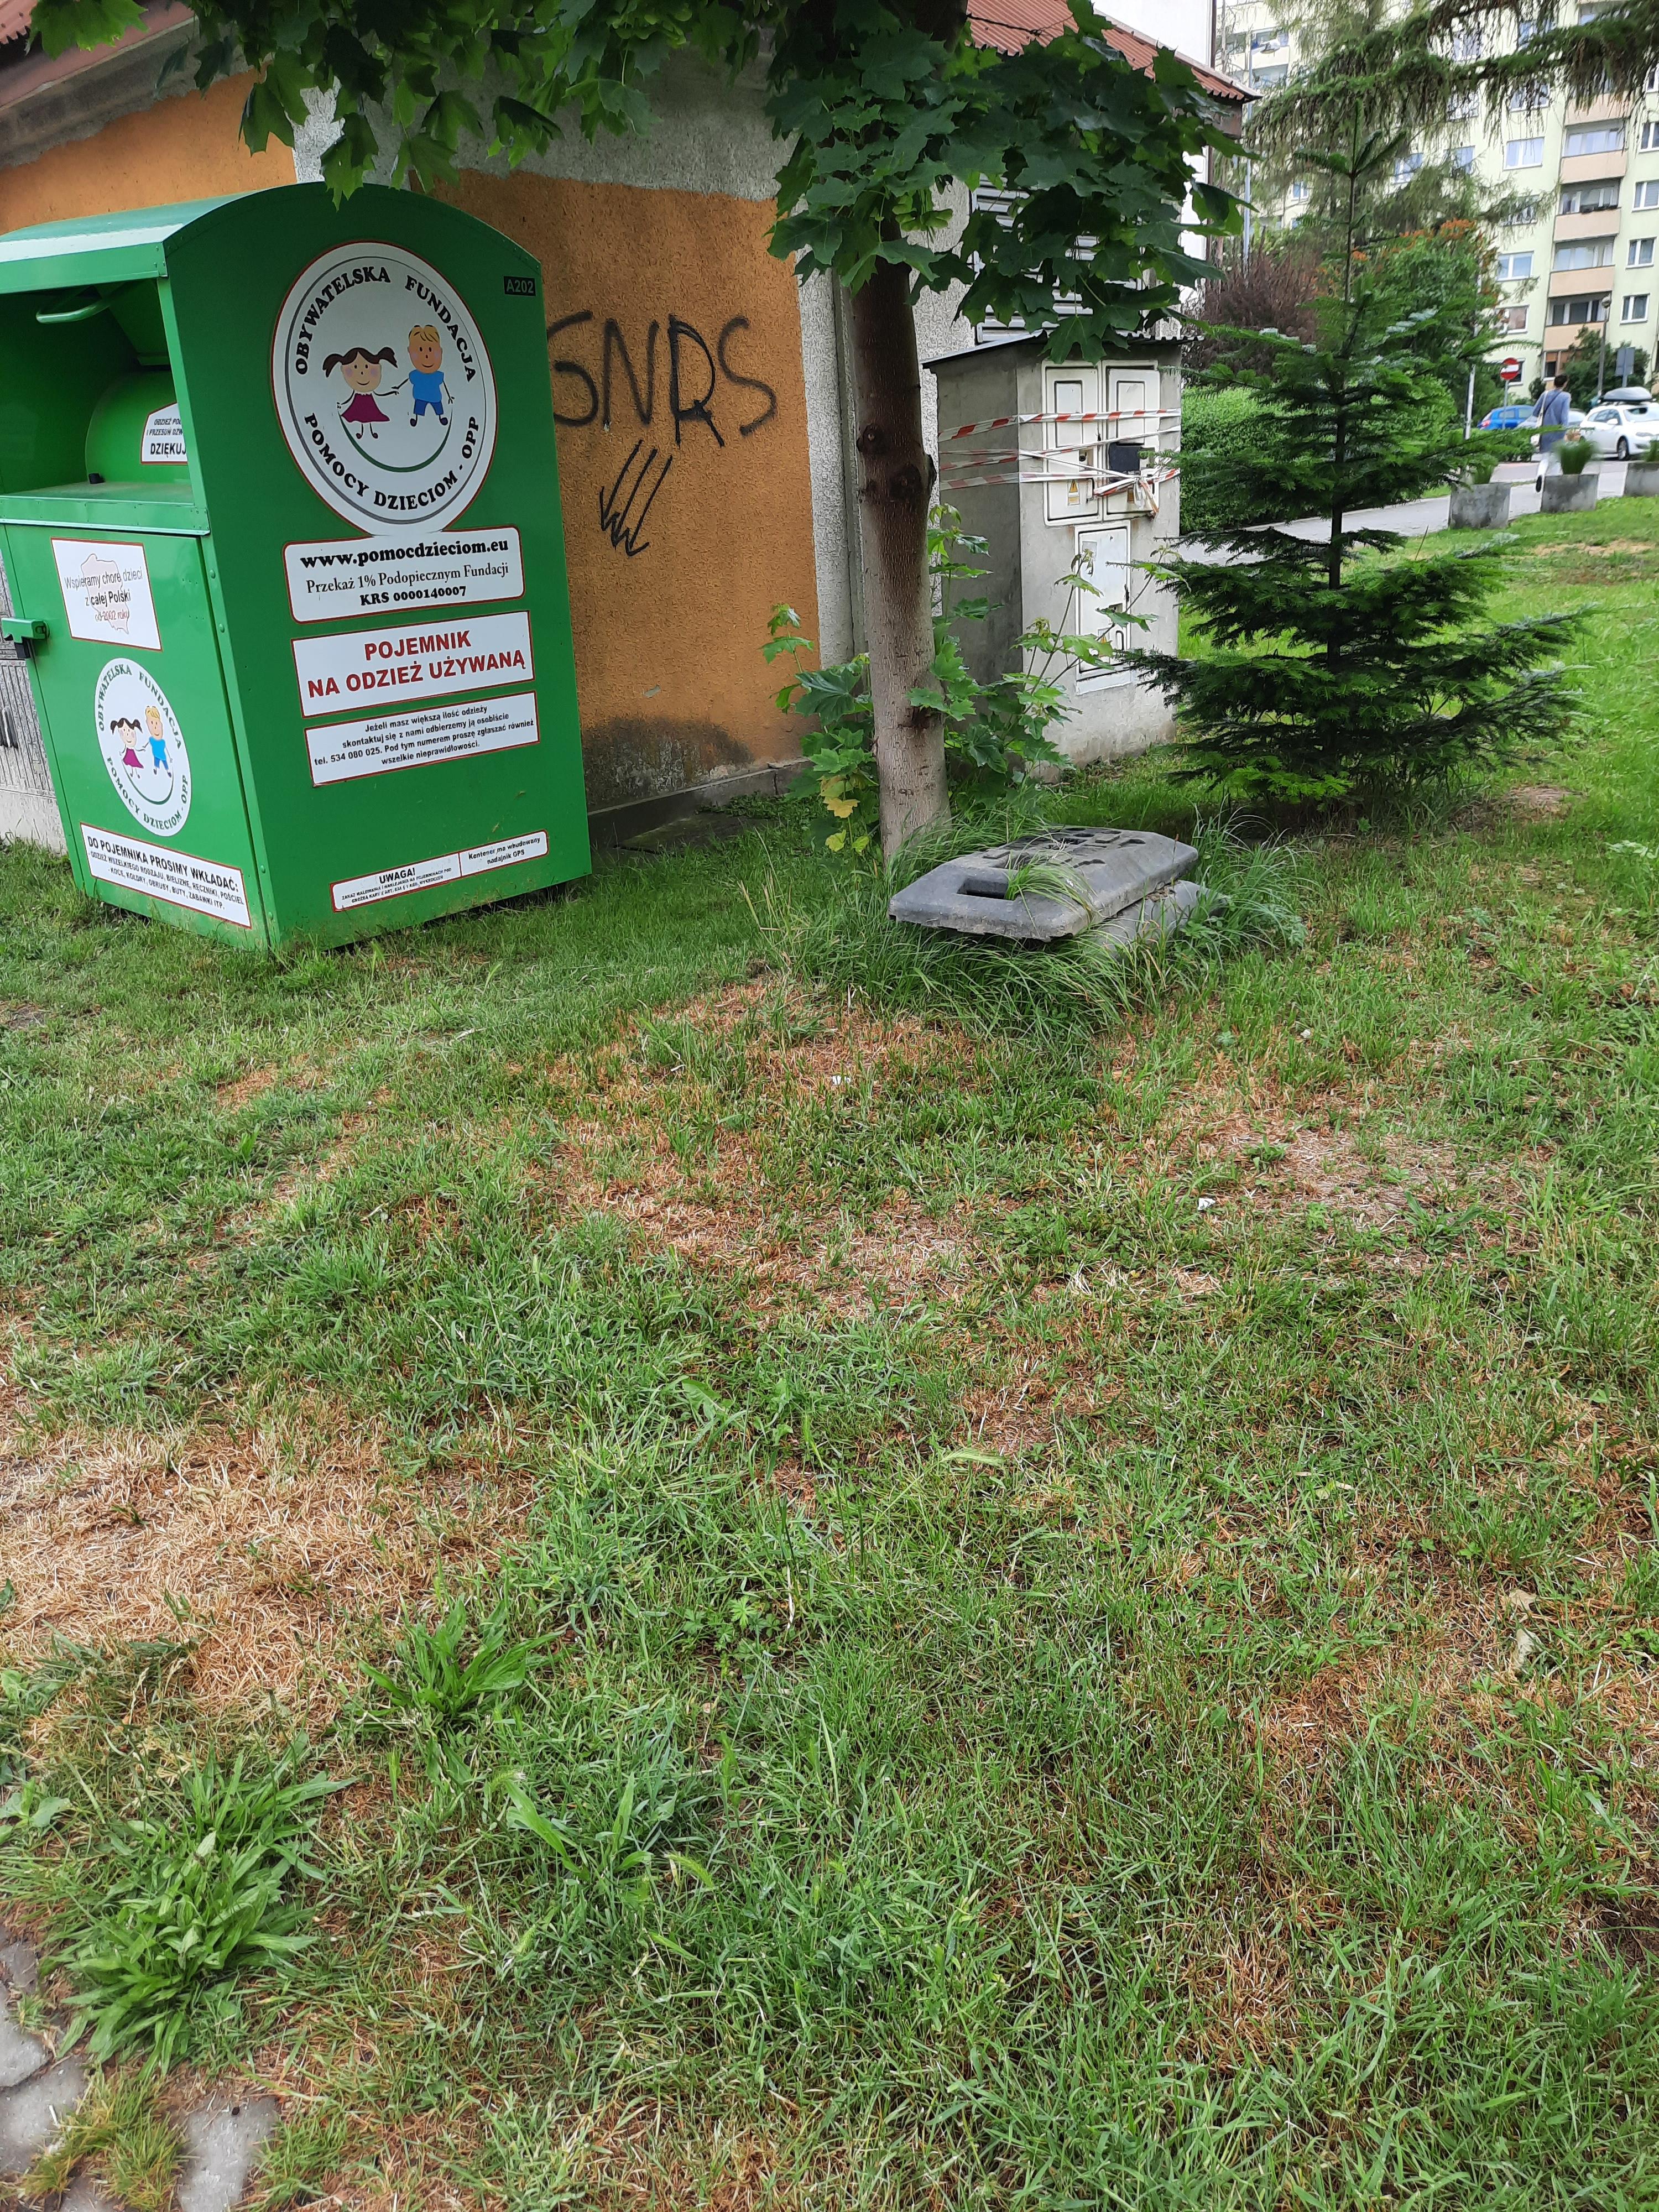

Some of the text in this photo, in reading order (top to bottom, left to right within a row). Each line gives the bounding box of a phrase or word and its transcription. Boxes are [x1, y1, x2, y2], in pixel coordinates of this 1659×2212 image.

[506, 280, 534, 294] A202
[295, 266, 477, 382] OBYWATELSKA FUNDACJA
[304, 413, 369, 497] POMOCY
[373, 471, 458, 510] DZIECIOM
[462, 416, 479, 458] OPP
[300, 539, 508, 568] www.pomocdzieciom.eu
[64, 566, 143, 591] Wspieramy chore dzieci
[306, 562, 509, 593] Przekaż 1% Podopiecznym Fundacji
[85, 597, 90, 606] z
[108, 589, 131, 604] Polski
[359, 586, 466, 606] KRS 0000140007
[364, 630, 472, 661] POJEMNIK
[307, 649, 526, 698] NA ODZIEŻ UŻYWANĄ
[98, 664, 182, 749] OBYWATELSKA FUNDACJA
[365, 721, 387, 732] Jeżeli
[390, 719, 409, 728] masz
[411, 713, 441, 725] większą
[462, 706, 487, 715] odzieży
[314, 757, 328, 765] tel.
[331, 753, 346, 763] 534
[348, 750, 363, 759] 080
[366, 747, 383, 756] 025.
[385, 744, 399, 753] Pod
[401, 742, 415, 751] tym
[508, 719, 534, 730] również
[342, 733, 384, 748] skontaktuj
[385, 733, 396, 741] się
[405, 727, 424, 737] nami
[426, 721, 467, 734] odbierzemy
[468, 719, 475, 728] ją
[477, 713, 509, 724] osobiście
[382, 753, 414, 765] wszelkie
[107, 757, 140, 814] POMOCY
[143, 809, 182, 831] DZIECIOM
[87, 836, 238, 893] DO POJEMNIKA PROSIMY WKŁADAĆ:
